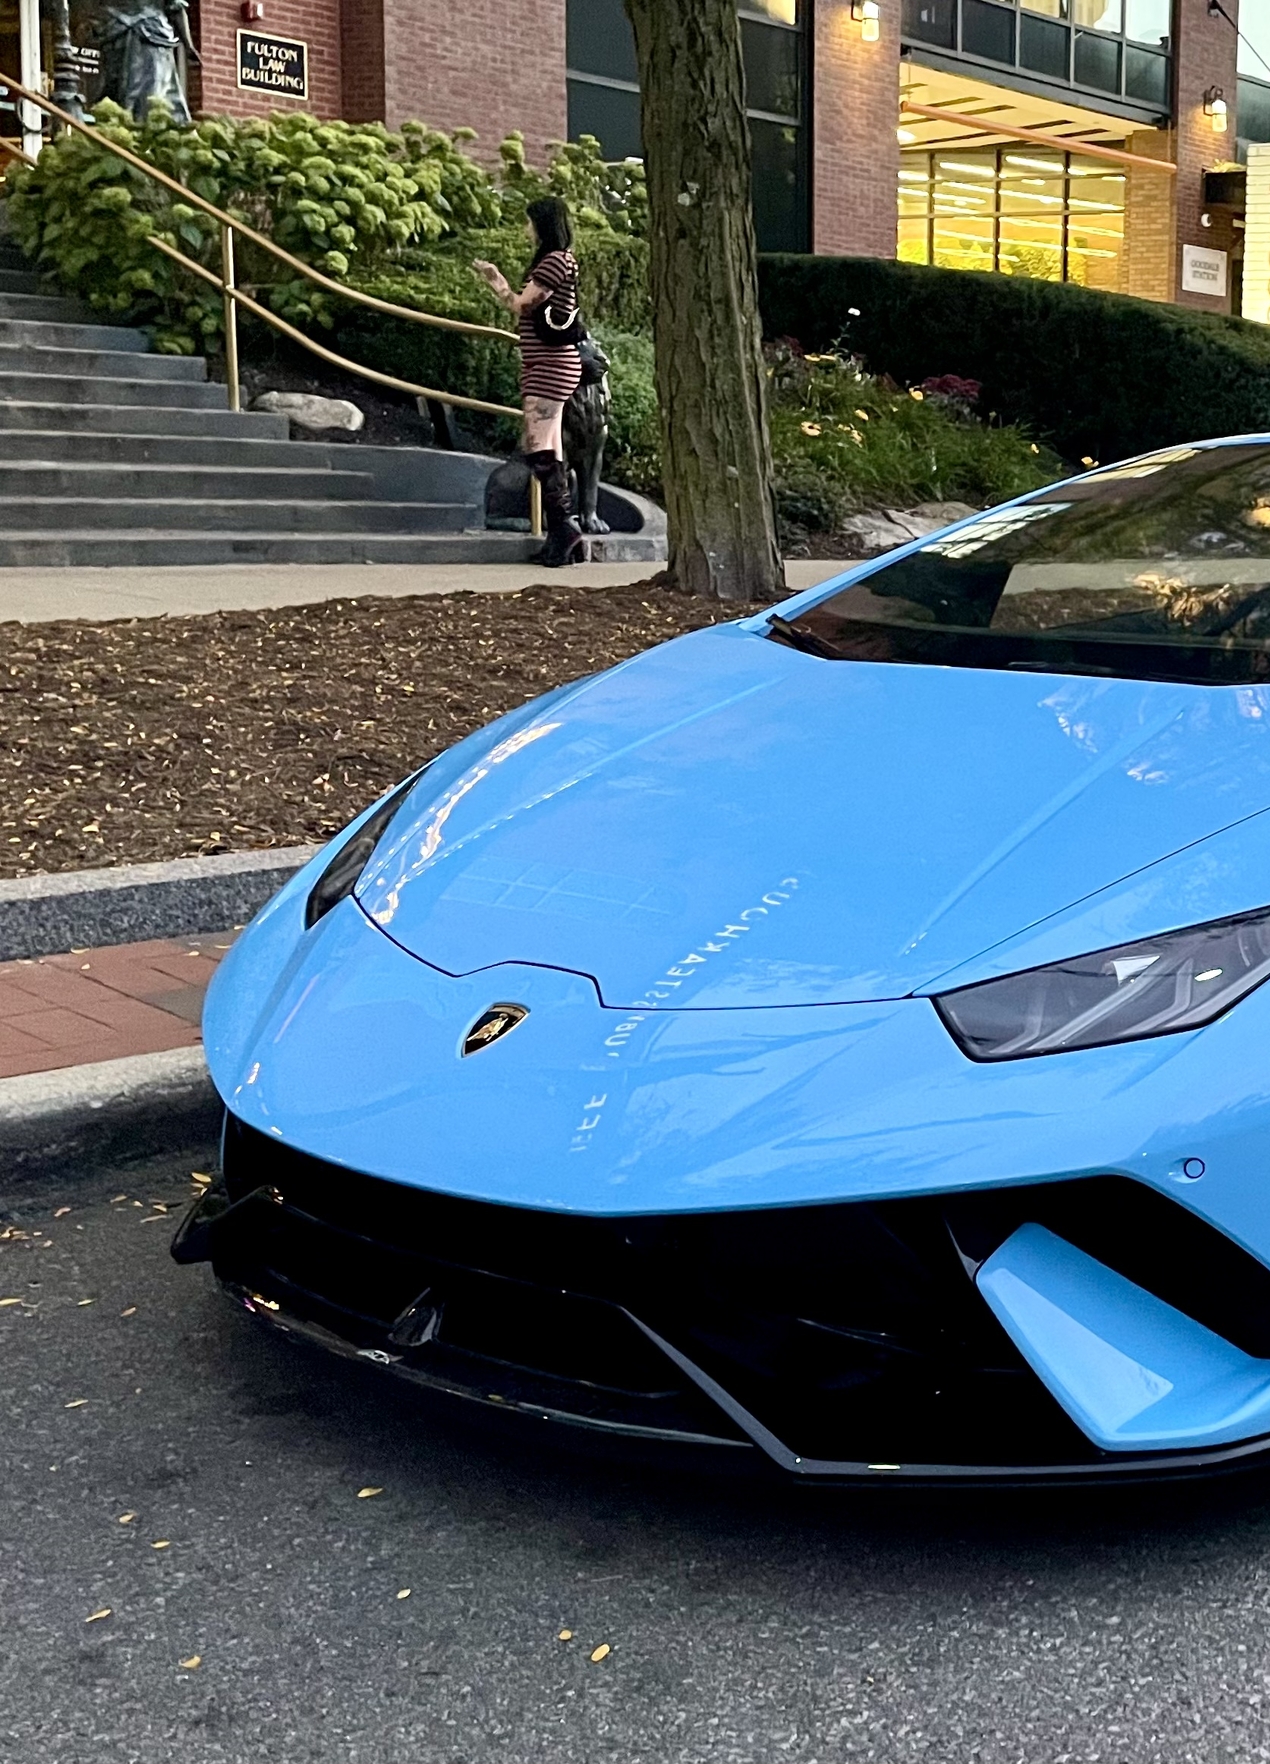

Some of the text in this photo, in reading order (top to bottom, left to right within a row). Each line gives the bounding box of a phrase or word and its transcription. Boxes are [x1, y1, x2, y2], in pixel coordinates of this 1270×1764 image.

[246, 41, 298, 62] FULTON
[258, 56, 286, 73] LAW
[241, 67, 304, 90] BUILDING
